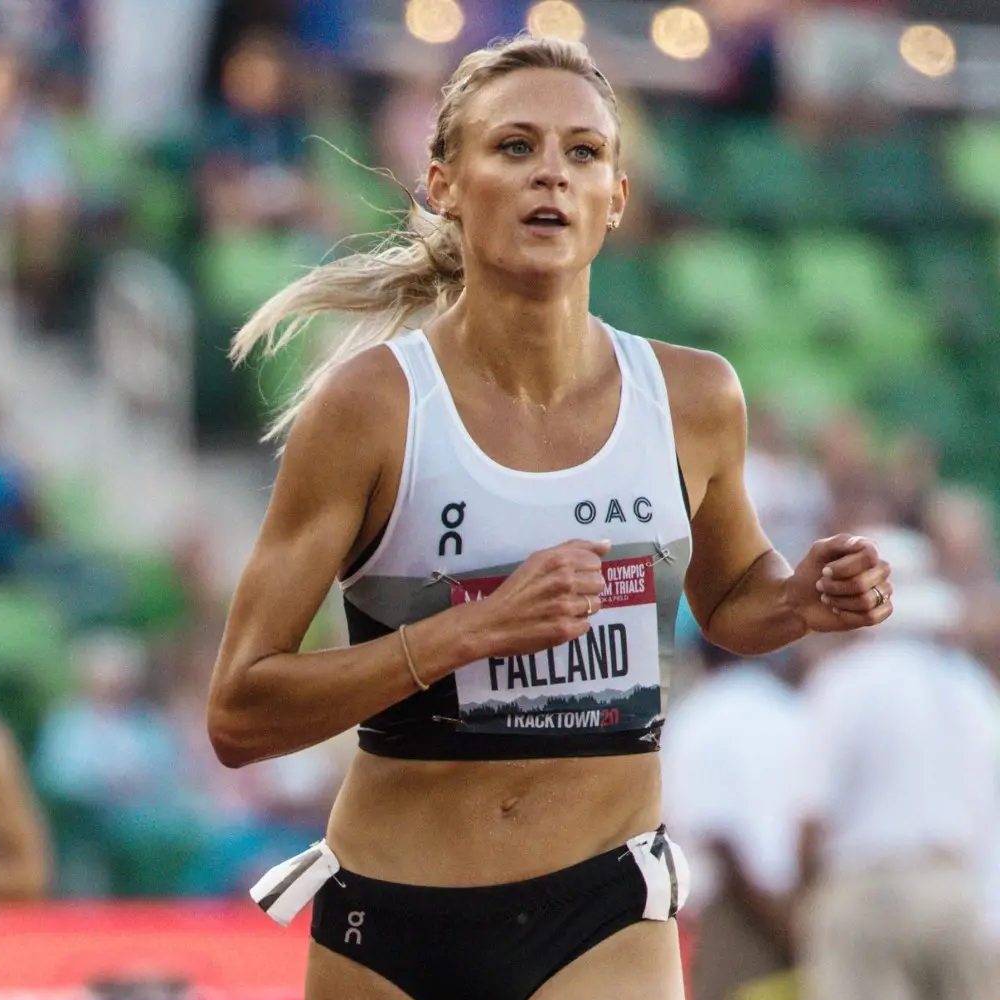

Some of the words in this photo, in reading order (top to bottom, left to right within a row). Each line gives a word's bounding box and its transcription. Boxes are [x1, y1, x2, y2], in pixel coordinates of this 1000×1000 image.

[607, 563, 645, 582] OLYMPIC
[614, 578, 645, 595] TRIALS
[488, 622, 629, 692] FALLAND
